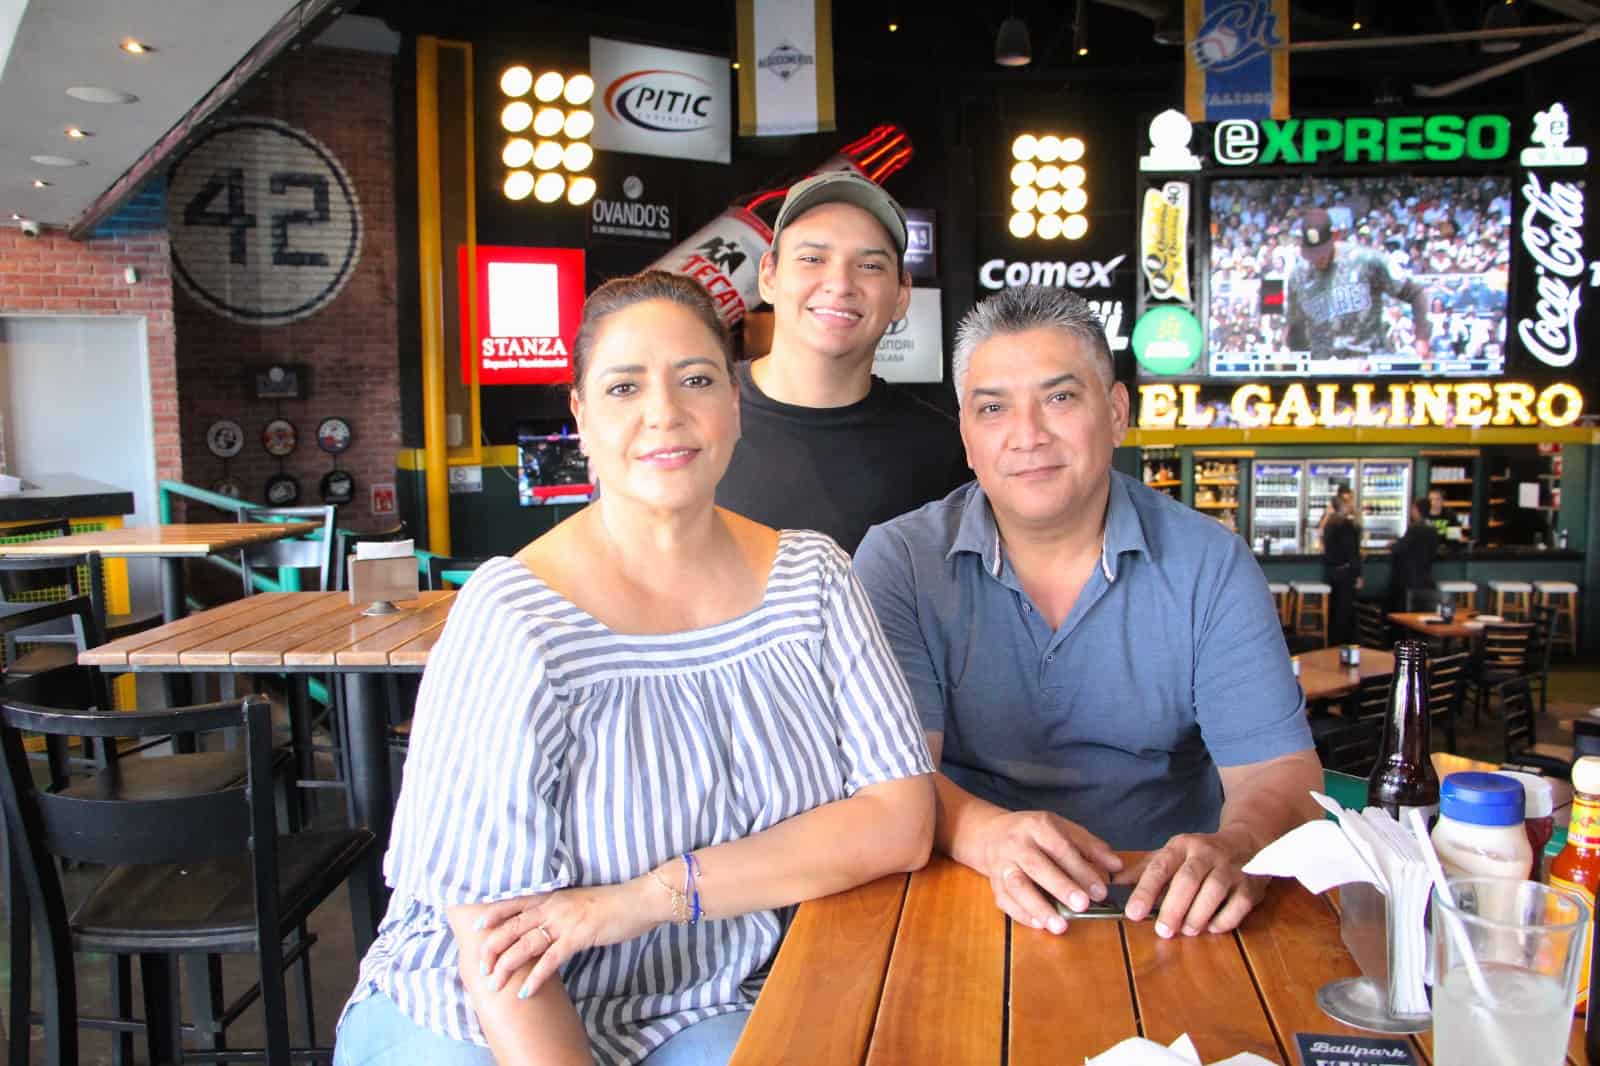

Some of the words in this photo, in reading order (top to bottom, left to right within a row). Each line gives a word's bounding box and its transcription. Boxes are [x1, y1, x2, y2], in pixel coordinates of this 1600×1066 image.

[635, 87, 712, 117] PITIC
[184, 167, 330, 267] 42
[592, 200, 670, 229] OVANDO'S
[482, 337, 568, 356] STANZA
[1137, 383, 1214, 428] EL
[1229, 383, 1584, 428] GALLINERO
[1309, 1041, 1408, 1058] Ballpark
